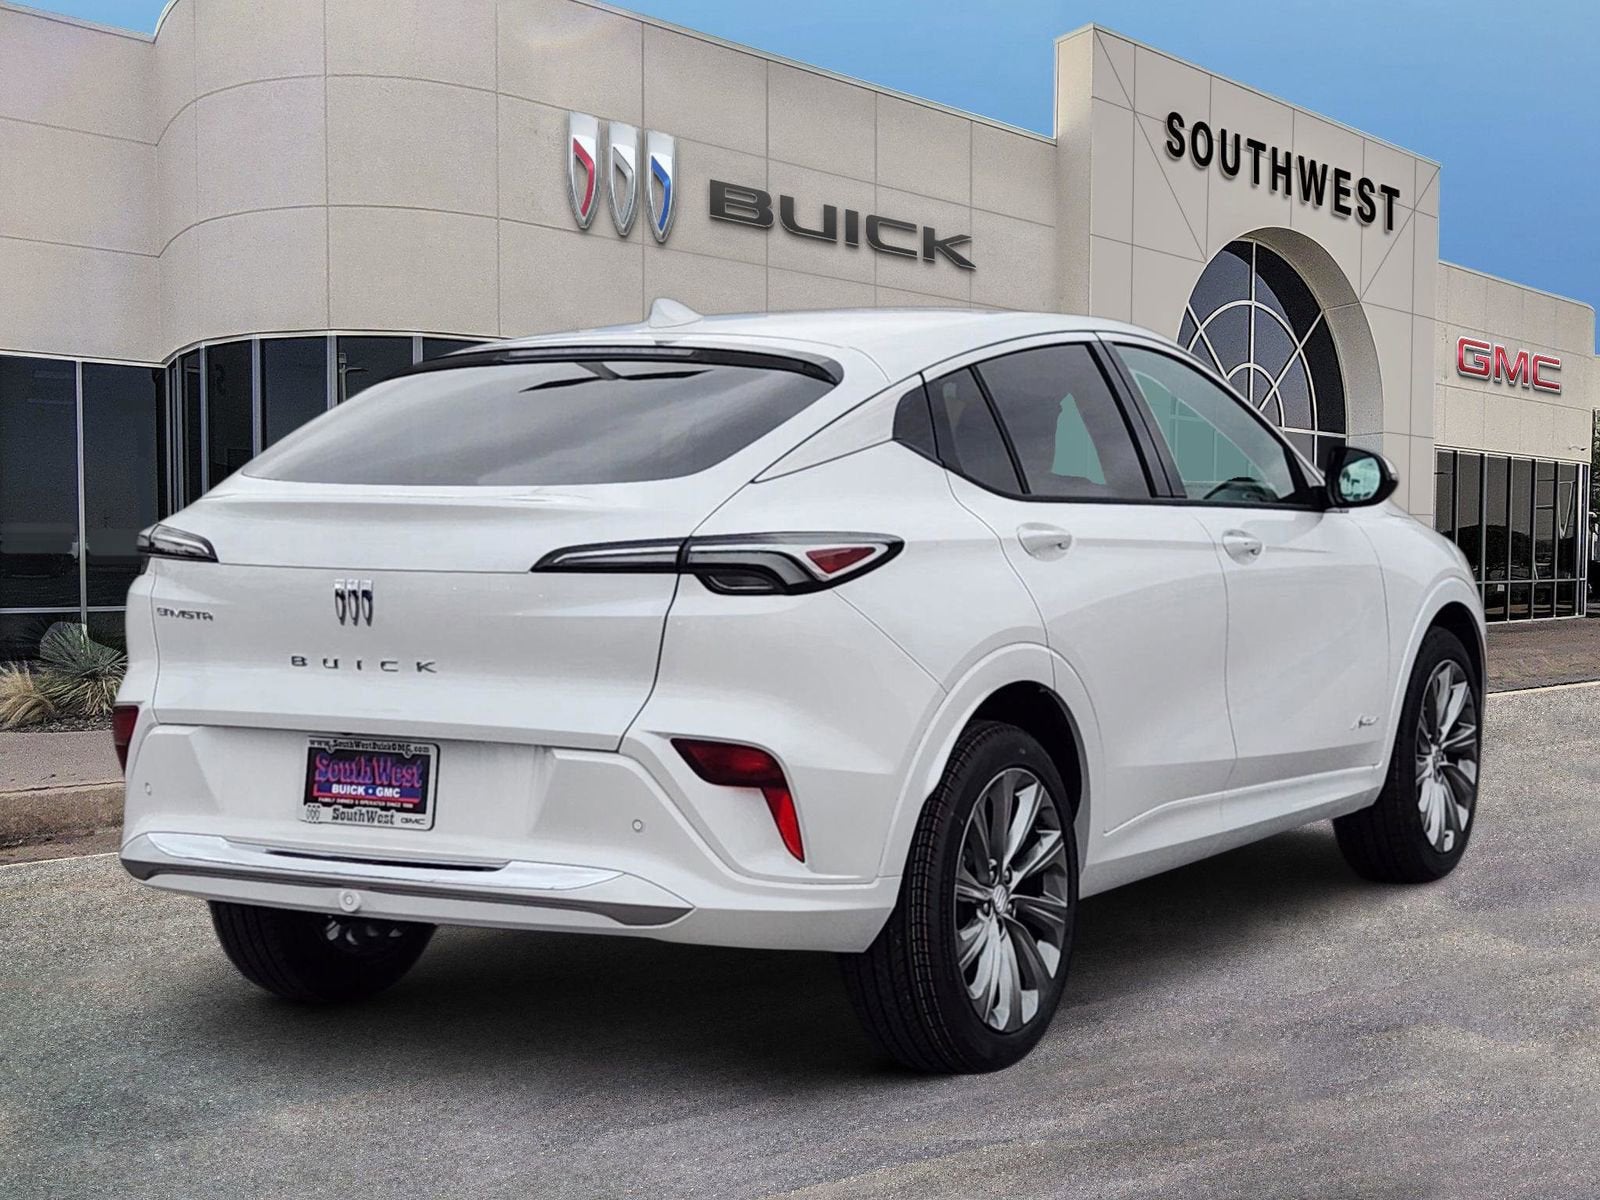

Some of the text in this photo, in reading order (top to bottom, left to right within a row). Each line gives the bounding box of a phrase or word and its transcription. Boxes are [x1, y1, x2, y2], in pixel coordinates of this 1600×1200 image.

[1166, 111, 1401, 232] SOUTHWEST
[709, 179, 977, 270] BUICK
[1457, 336, 1561, 394] GMC
[291, 655, 437, 673] BUICK
[331, 783, 401, 798] BUICK GMC
[400, 817, 426, 826] GMC
